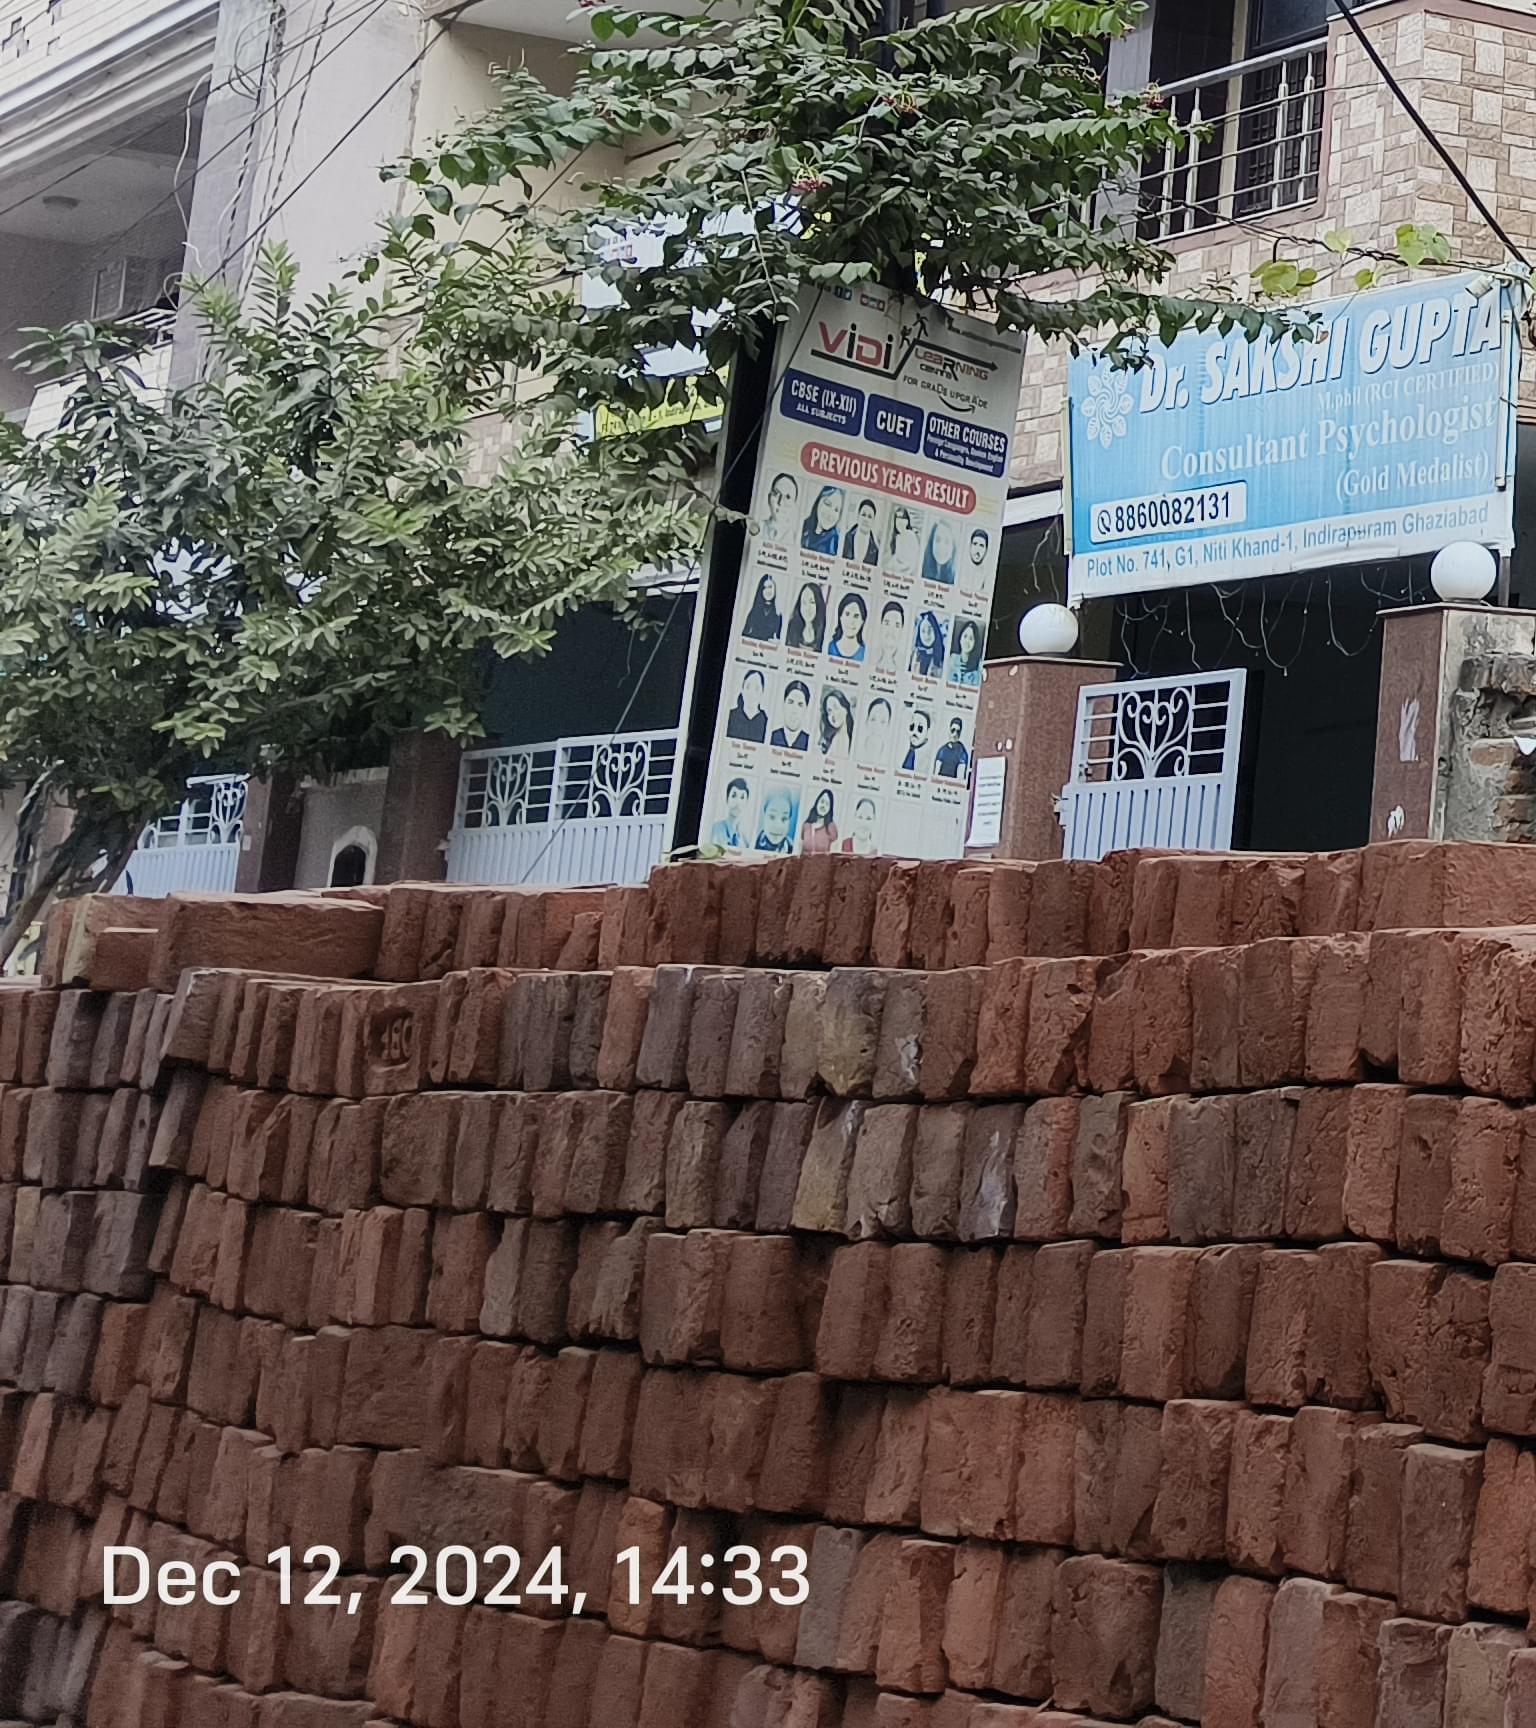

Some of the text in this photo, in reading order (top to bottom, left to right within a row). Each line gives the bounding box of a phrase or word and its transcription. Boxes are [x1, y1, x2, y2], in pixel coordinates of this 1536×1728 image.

[1139, 285, 1502, 414] Dr. SAKSHI GUPTA
[791, 379, 857, 418] CBSE (IX-XII)
[903, 375, 988, 408] FOR GRADE UPGRADE
[1365, 379, 1399, 408] (RCI
[1404, 360, 1500, 394] CERTIFIED)
[796, 402, 847, 425] ALL SUBJECTS
[876, 410, 914, 439] CUET
[929, 416, 960, 440] OTHER
[962, 428, 1006, 453] COURSES
[1161, 393, 1499, 481] Consultant Psychologist
[810, 447, 970, 509] PREVIOUS YEAR'S RESULT
[1336, 450, 1490, 504] (Gold Medalist)
[1115, 491, 1230, 533] 8860082131
[1087, 500, 1489, 577] Plot No. 741, G1, Niti Khand-1, Indirapuram Ghaziabad
